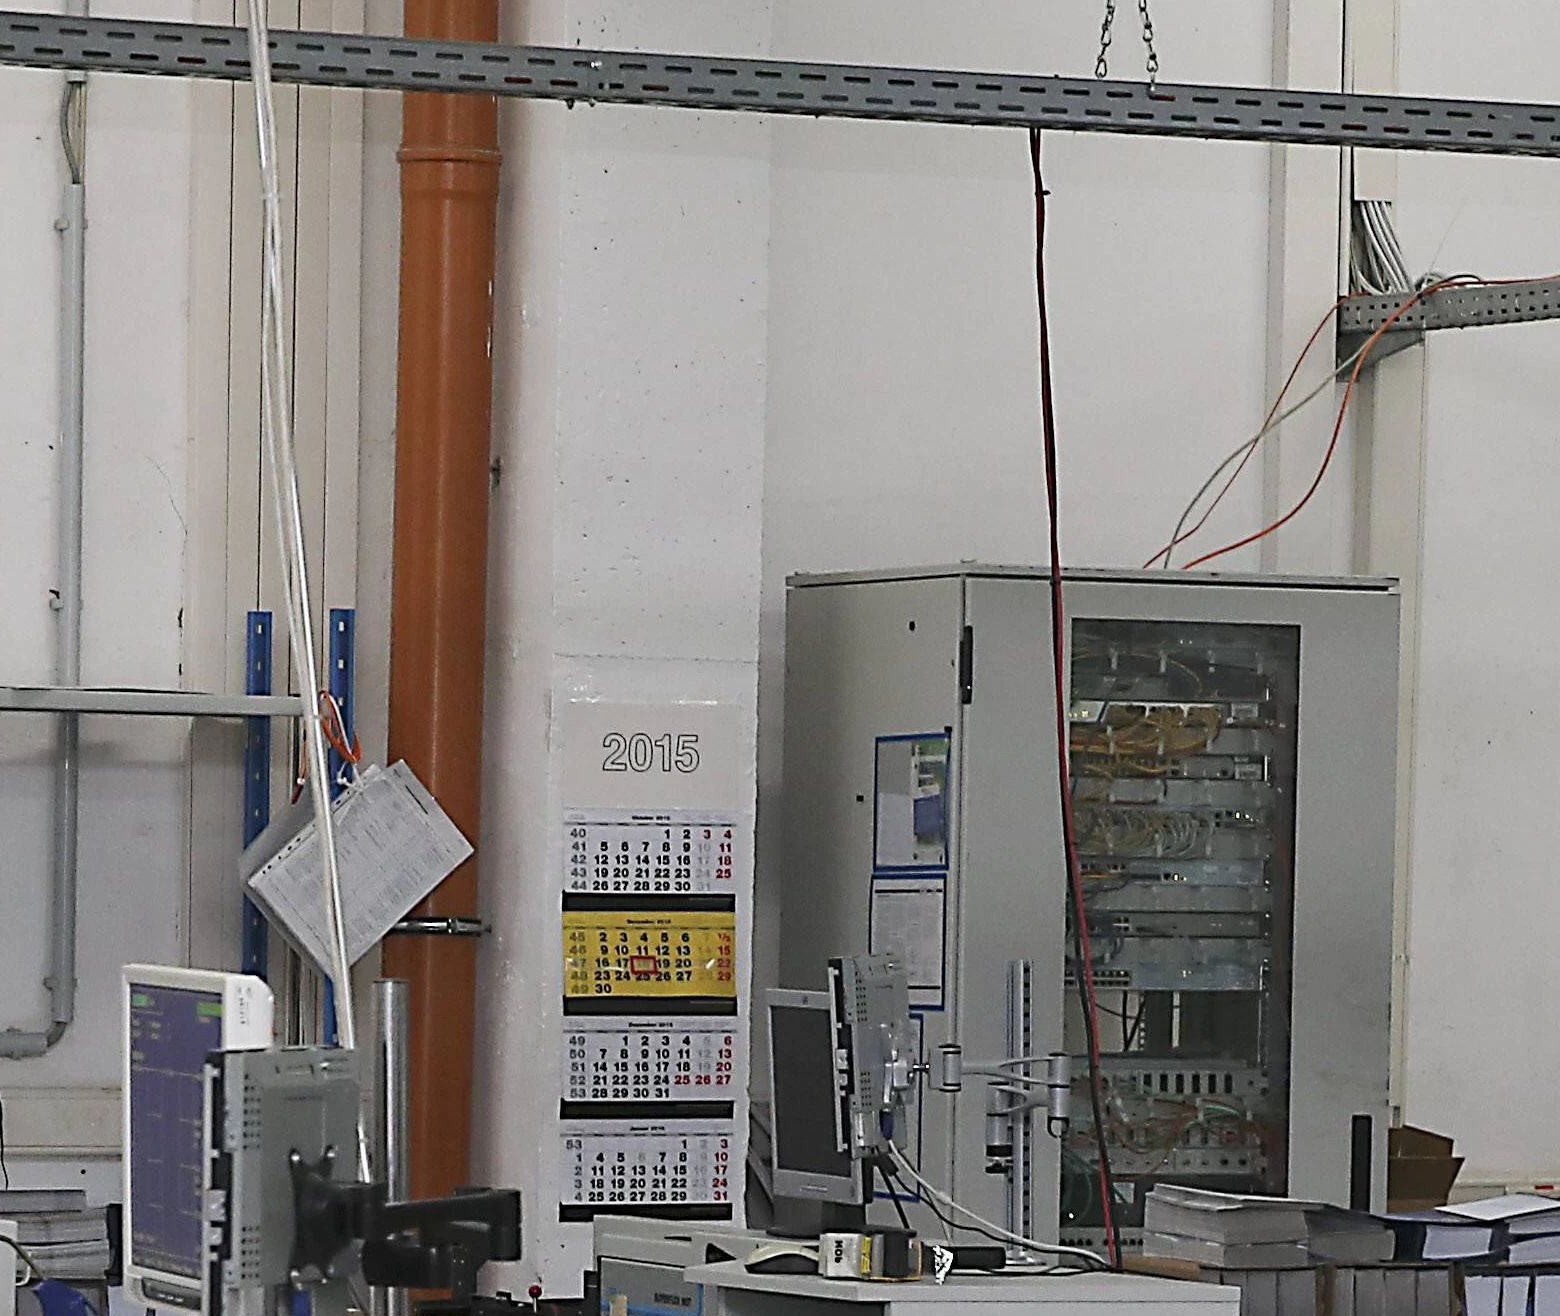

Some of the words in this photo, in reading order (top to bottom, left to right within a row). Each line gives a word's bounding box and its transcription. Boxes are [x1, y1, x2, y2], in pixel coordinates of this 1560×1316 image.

[602, 732, 700, 773] 2015
[665, 829, 670, 839] 1
[683, 829, 690, 839] 2
[704, 830, 710, 839] 3
[724, 830, 731, 838] 4
[601, 842, 608, 851] 5
[621, 842, 629, 851] 6
[642, 842, 649, 852] 7
[663, 842, 670, 852] 8
[683, 842, 690, 852] 9
[720, 843, 731, 852] 11
[595, 855, 608, 864] 12
[616, 855, 629, 865] 13
[636, 855, 649, 865] 14
[656, 855, 670, 865] 15
[677, 855, 690, 865] 16
[719, 856, 731, 865] 18
[595, 868, 608, 878] 19
[614, 868, 629, 878] 20
[636, 868, 649, 878] 21
[655, 868, 670, 878] 22
[675, 869, 690, 878] 23
[716, 869, 731, 878] 25
[593, 881, 608, 890] 26
[614, 881, 628, 891] 27
[634, 881, 649, 891] 28
[655, 881, 670, 891] 29
[675, 881, 690, 891] 30
[600, 932, 607, 942] 2
[620, 933, 627, 942] 3
[640, 933, 648, 942] 4
[661, 933, 668, 942] 5
[682, 933, 689, 942] 6
[601, 945, 608, 955] 9
[615, 945, 628, 957] 10
[636, 946, 650, 955] 11
[656, 945, 670, 955] 12
[677, 946, 690, 955] 13
[718, 945, 730, 955] 15
[595, 959, 611, 968] 16
[615, 959, 630, 968] 17
[656, 959, 671, 968] 19
[676, 959, 692, 968] 20
[595, 971, 610, 980] 23
[615, 971, 632, 981] 24
[654, 970, 671, 981] 26
[676, 971, 692, 981] 27
[595, 984, 611, 993] 30
[623, 1036, 628, 1046] 1
[641, 1036, 649, 1046] 2
[662, 1036, 669, 1046] 3
[683, 1036, 690, 1045] 4
[724, 1036, 731, 1045] 6
[600, 1049, 607, 1059] 7
[620, 1049, 628, 1059] 8
[641, 1049, 649, 1059] 9
[656, 1049, 669, 1059] 10
[678, 1049, 690, 1059] 11
[719, 1049, 731, 1058] 13
[593, 1062, 607, 1072] 14
[614, 1062, 628, 1072] 15
[635, 1062, 649, 1072] 16
[656, 1062, 669, 1072] 17
[676, 1062, 690, 1071] 18
[716, 1062, 731, 1071] 20
[593, 1075, 607, 1085] 21
[613, 1075, 628, 1085] 22
[633, 1075, 649, 1085] 23
[654, 1075, 669, 1085] 24
[675, 1075, 690, 1085] 25
[696, 1075, 710, 1084] 26
[716, 1075, 730, 1085] 27
[592, 1088, 607, 1098] 28
[613, 1088, 628, 1098] 29
[633, 1088, 649, 1098] 30
[655, 1088, 669, 1098] 31
[682, 1140, 686, 1149] 1
[721, 1139, 728, 1148] 3
[596, 1153, 604, 1162] 4
[617, 1153, 625, 1162] 5
[660, 1152, 666, 1162] 7
[679, 1152, 687, 1162] 8
[715, 1152, 728, 1161] 10
[592, 1166, 603, 1176] 11
[612, 1166, 625, 1175] 12
[632, 1165, 645, 1175] 13
[653, 1165, 666, 1175] 14
[673, 1165, 686, 1175] 15
[715, 1165, 727, 1174] 17
[590, 1179, 604, 1188] 18
[611, 1179, 625, 1189] 19
[630, 1179, 645, 1188] 20
[652, 1178, 666, 1188] 21
[671, 1178, 687, 1188] 22
[713, 1178, 727, 1188] 24
[589, 1192, 604, 1202] 25
[609, 1192, 625, 1201] 26
[630, 1191, 645, 1201] 27
[651, 1191, 666, 1201] 28
[671, 1191, 686, 1201] 29
[714, 1191, 727, 1200] 31
